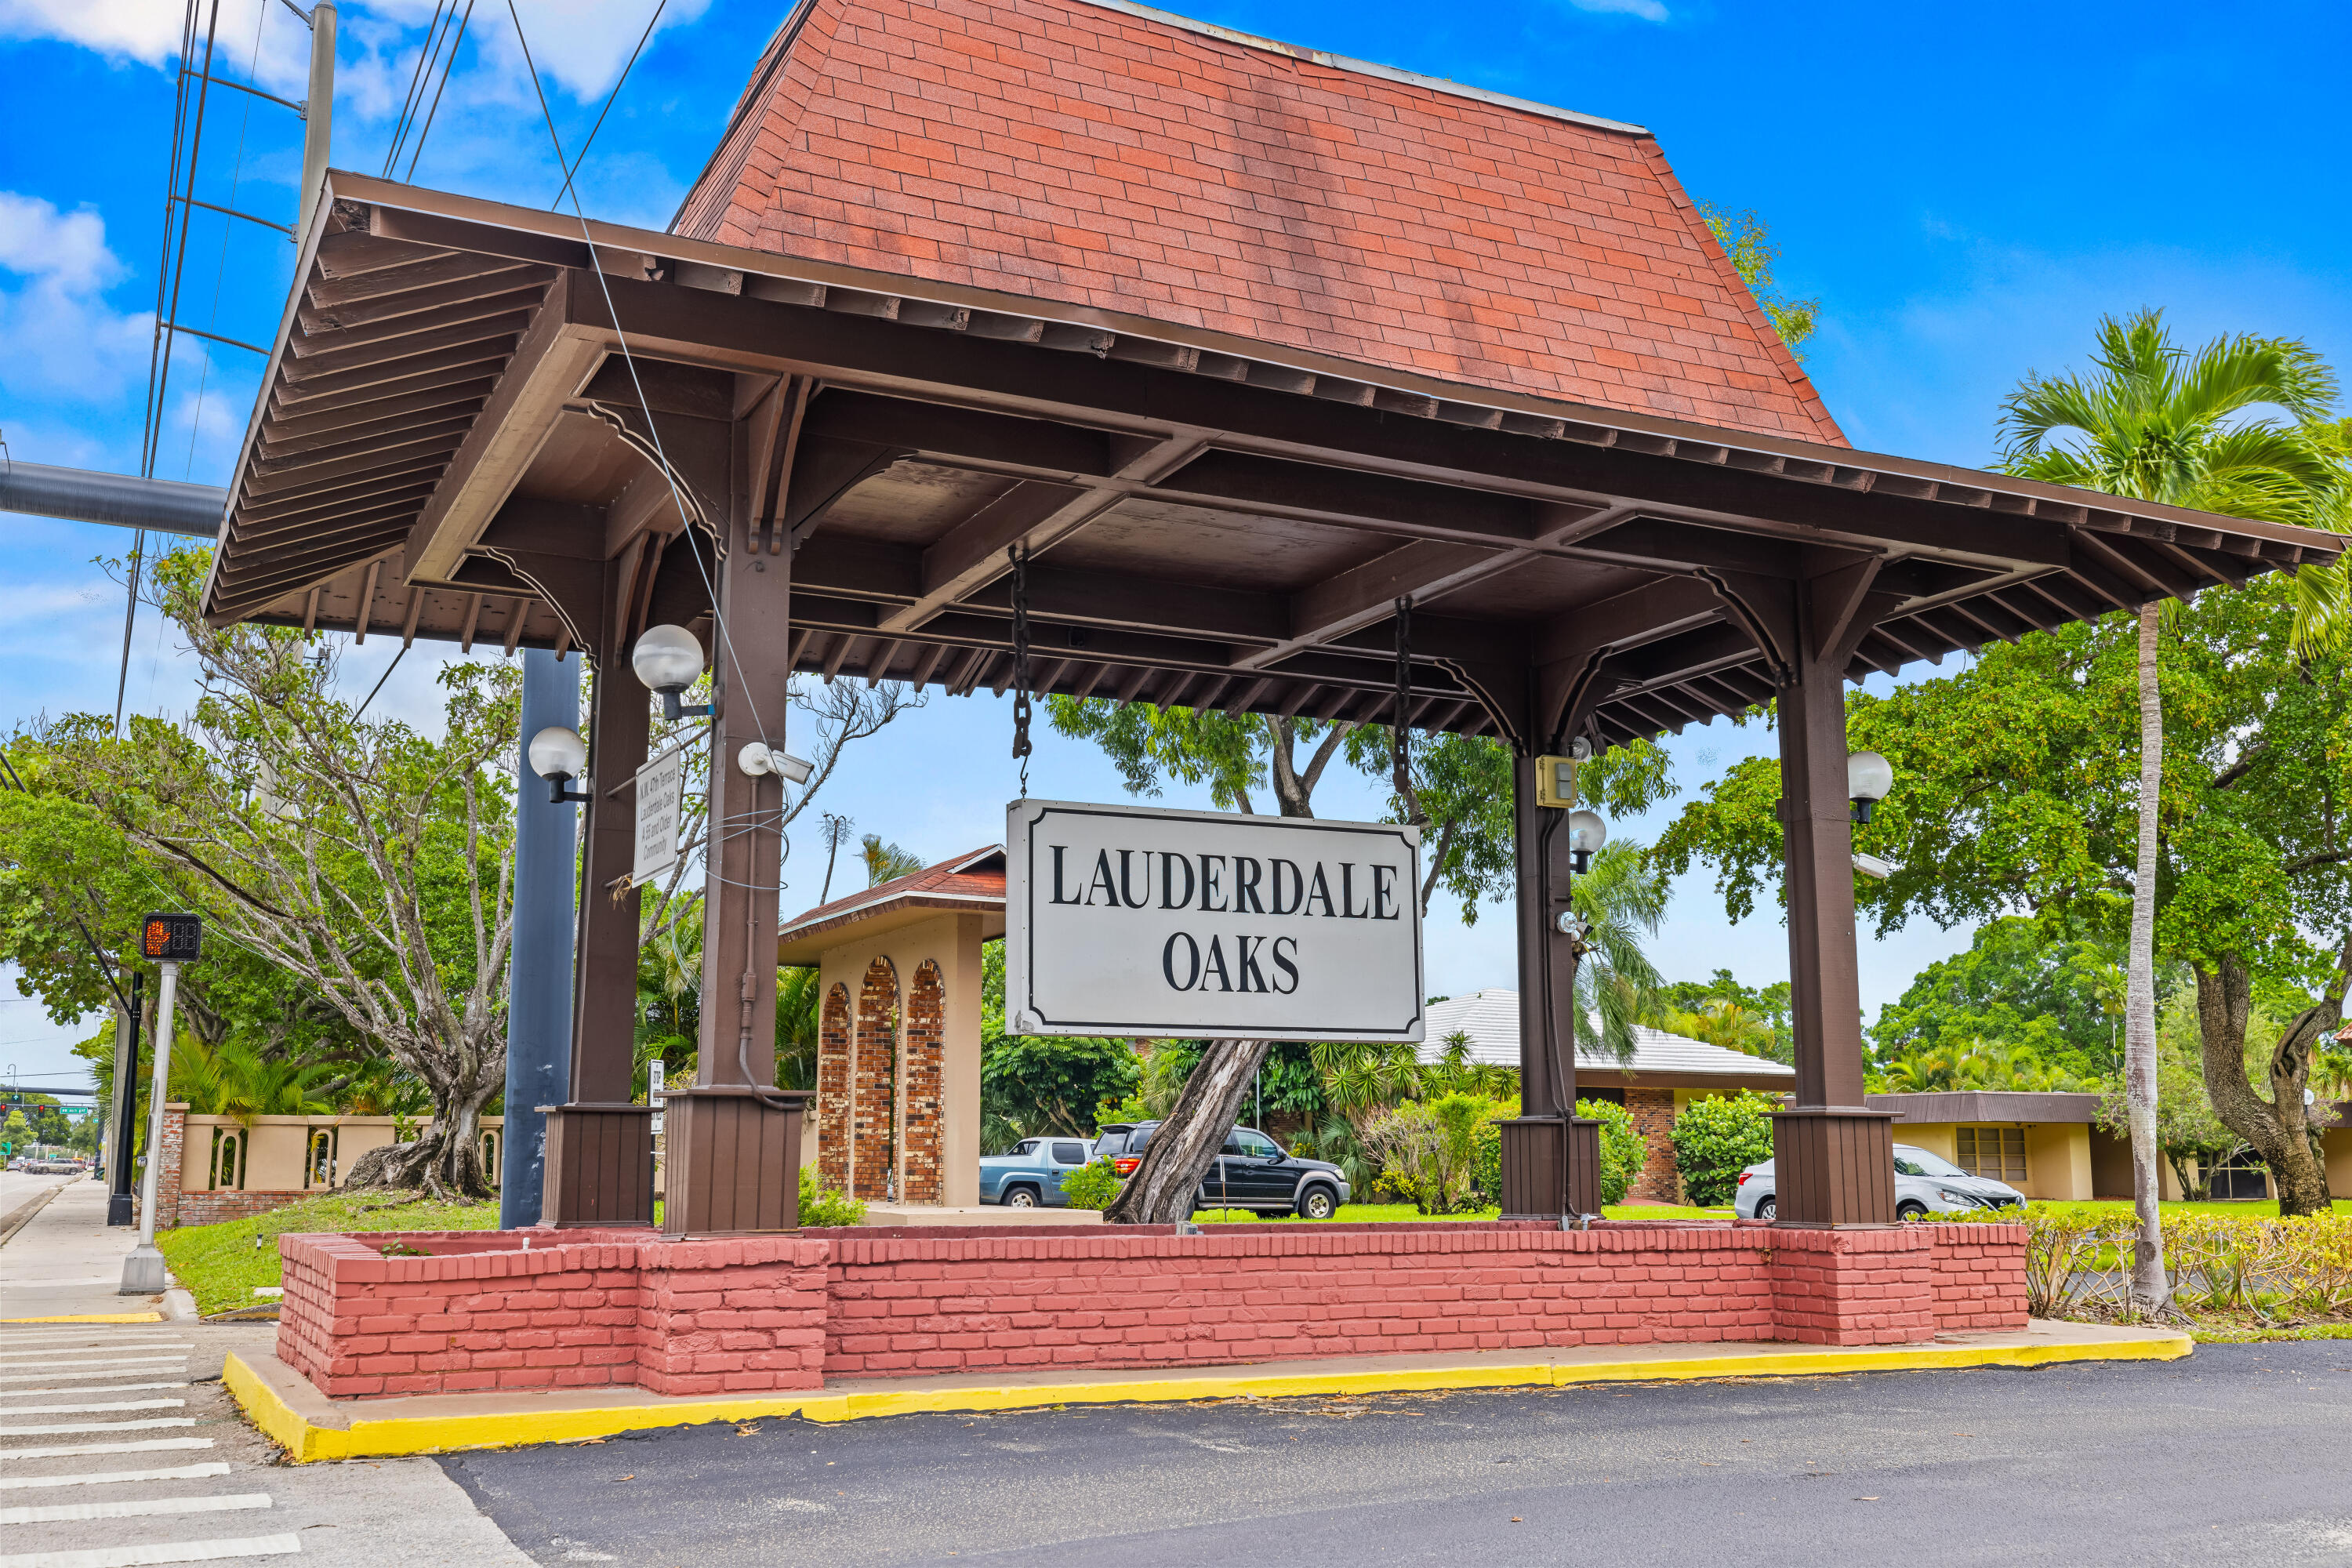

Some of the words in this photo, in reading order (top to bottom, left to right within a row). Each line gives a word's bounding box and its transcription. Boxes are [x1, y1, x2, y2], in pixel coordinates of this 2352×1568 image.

[650, 776, 659, 793] 47th
[659, 768, 675, 787] Terrace
[640, 796, 662, 822] Lauderdale
[663, 789, 674, 808] Oaks
[641, 827, 645, 843] A
[645, 822, 651, 840] 55
[651, 818, 659, 837] and
[659, 812, 672, 833] Older
[643, 836, 667, 860] Community
[1048, 844, 1400, 920] LAUDERDALE
[1163, 931, 1299, 995] OAKS
